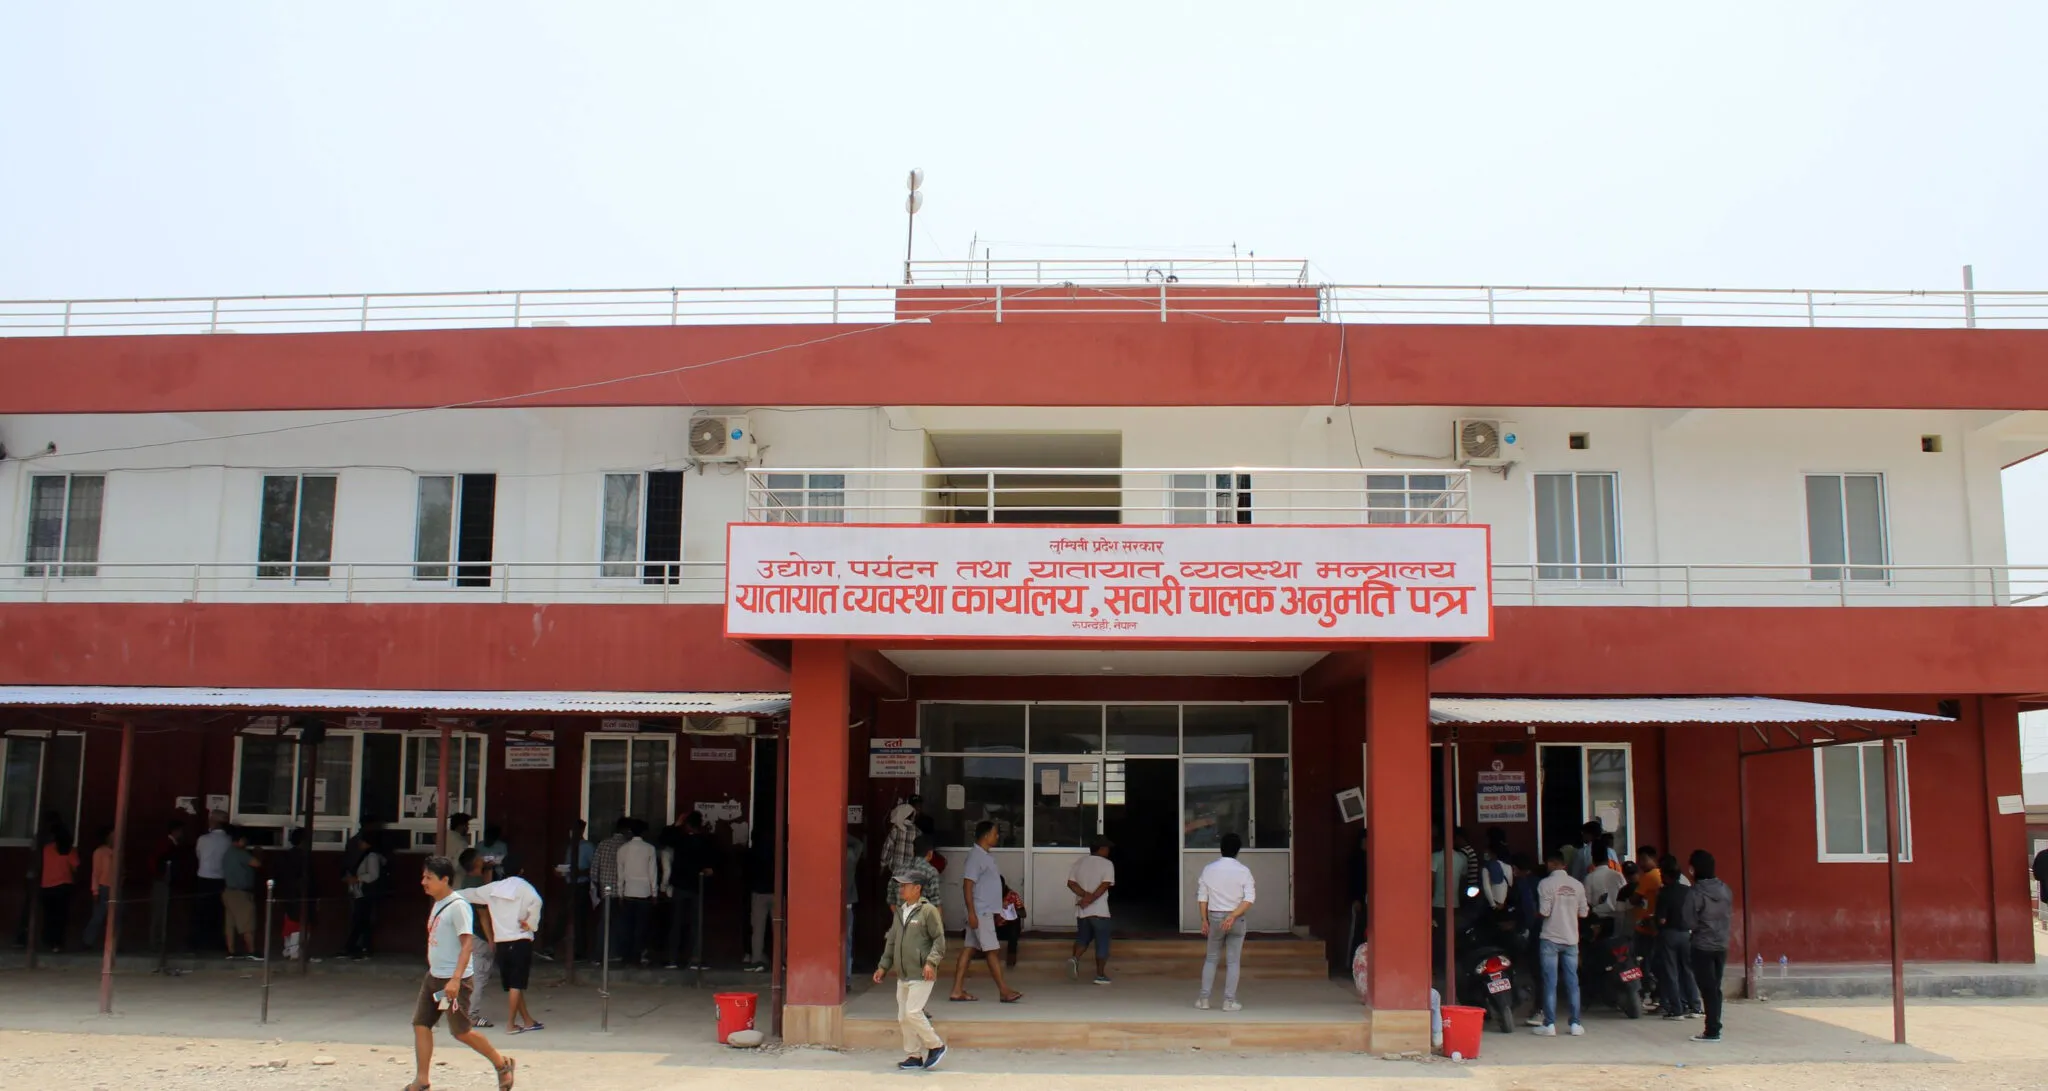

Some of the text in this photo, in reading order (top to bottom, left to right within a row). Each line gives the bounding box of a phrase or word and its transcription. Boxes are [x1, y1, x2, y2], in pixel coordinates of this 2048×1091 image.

[1093, 537, 1119, 553] प्रदेश
[1122, 541, 1164, 554] सरकार
[848, 555, 939, 580] पर्यटन
[956, 561, 1012, 581] तथा
[1028, 561, 1165, 580] यातायात
[1179, 561, 1302, 580] व्यवस्था
[1316, 561, 1456, 580] मन्त्रालय
[735, 584, 840, 616] यातायात
[843, 584, 948, 616] व्यवस्था
[1104, 574, 1184, 617] सवारी
[1188, 585, 1277, 615] चालक
[1280, 579, 1402, 628] अनुमति
[1406, 586, 1477, 618] पत्र
[1113, 619, 1138, 630] नेपाल
